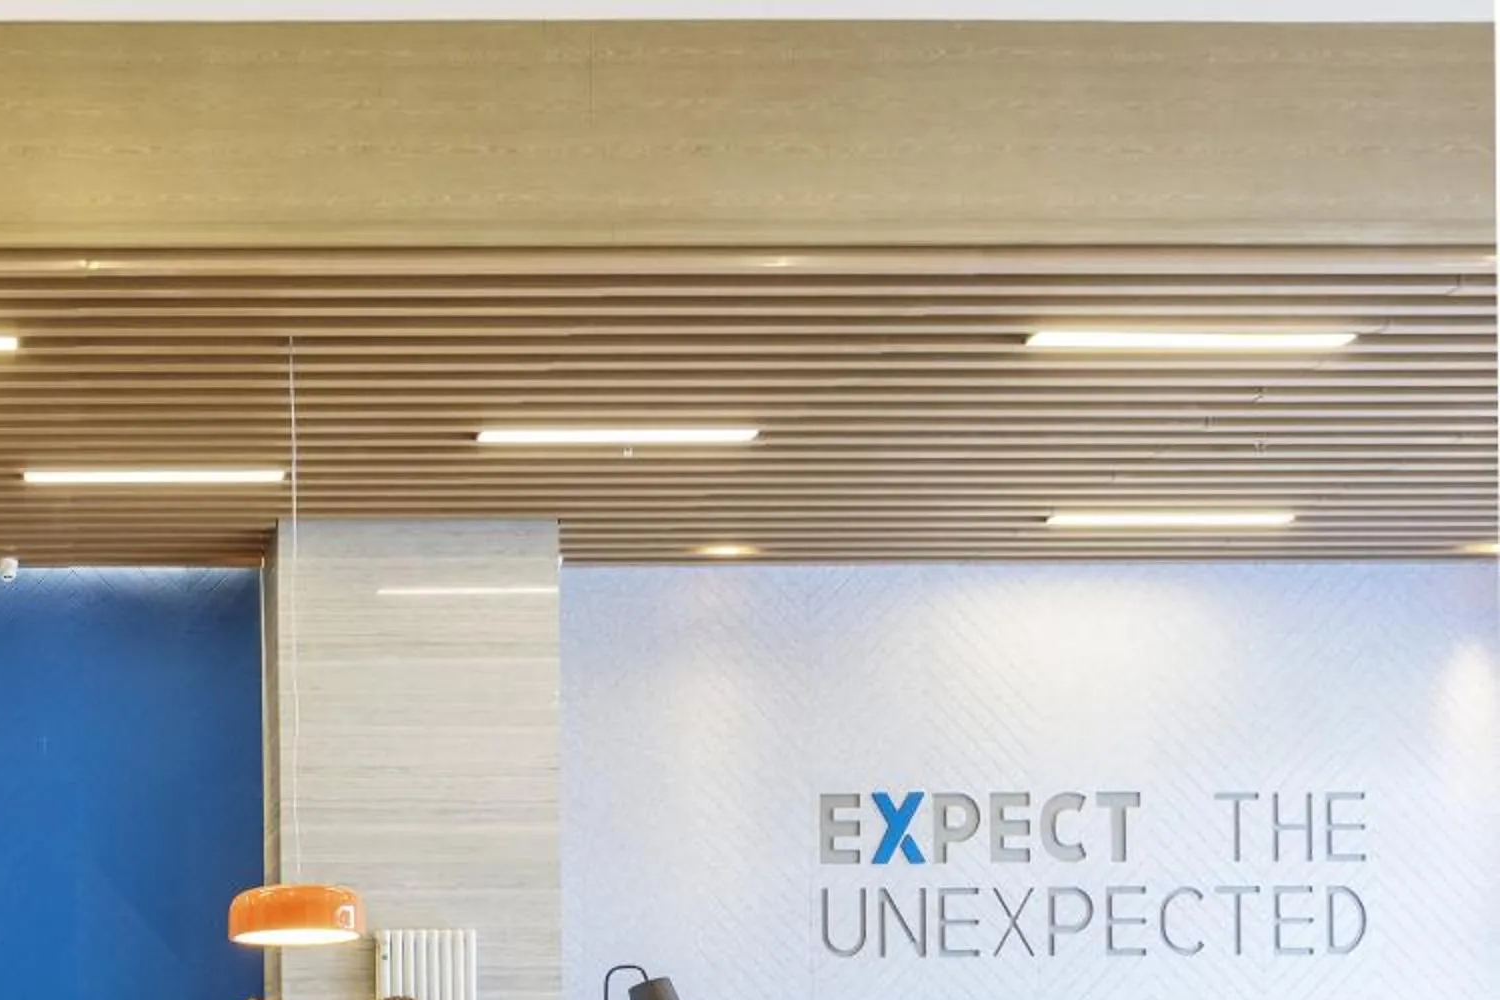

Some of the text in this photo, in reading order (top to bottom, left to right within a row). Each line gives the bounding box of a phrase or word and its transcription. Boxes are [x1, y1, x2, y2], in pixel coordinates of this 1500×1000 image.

[819, 791, 1367, 864] EXPECT THE
[821, 885, 1368, 957] UNEXPECTED
